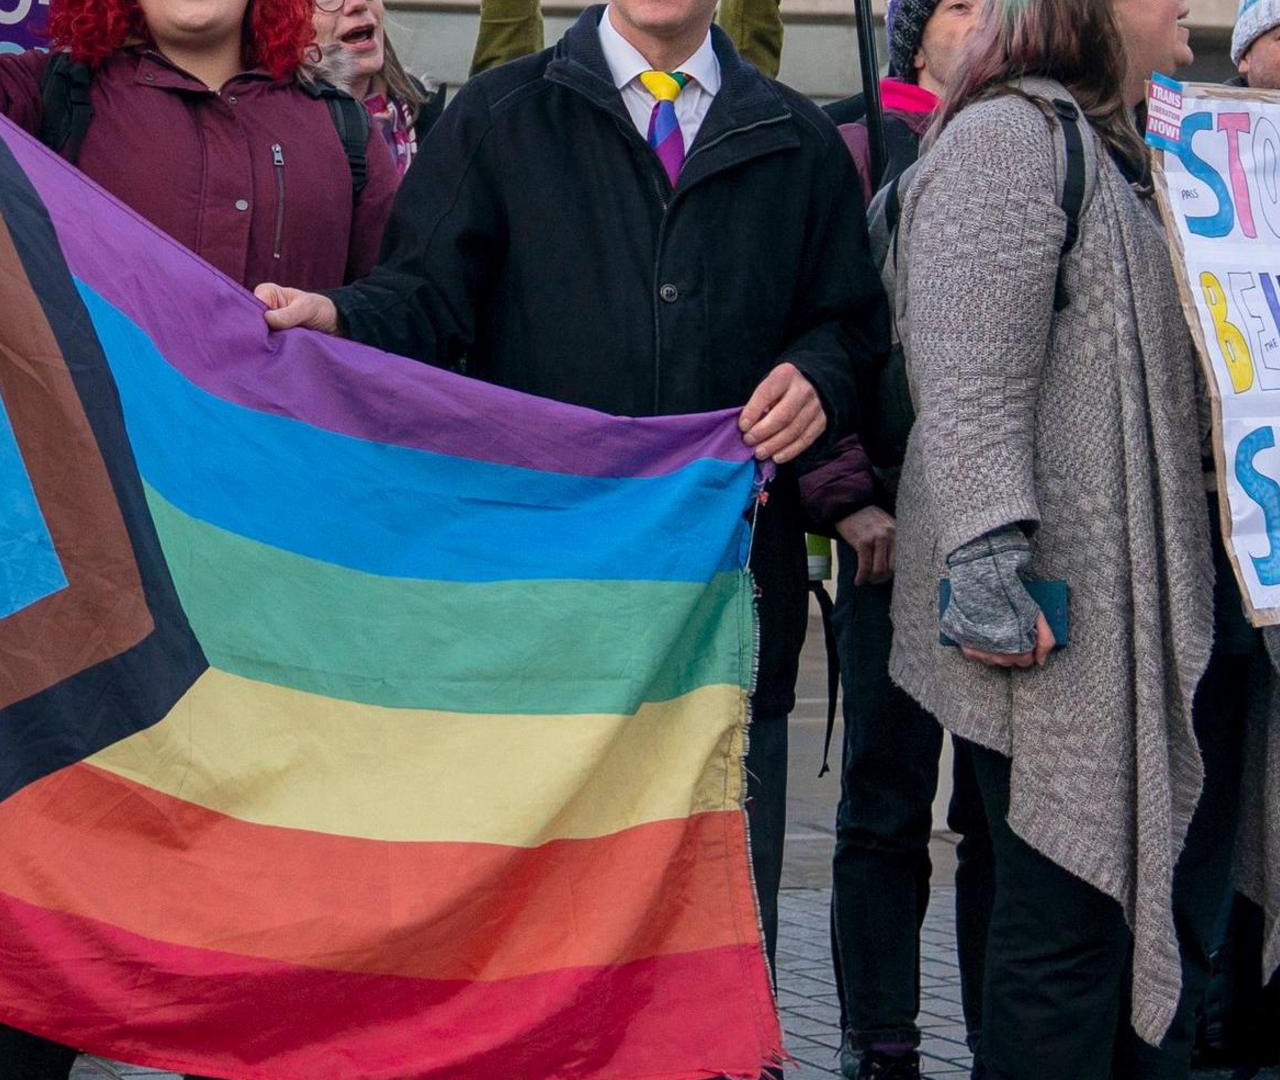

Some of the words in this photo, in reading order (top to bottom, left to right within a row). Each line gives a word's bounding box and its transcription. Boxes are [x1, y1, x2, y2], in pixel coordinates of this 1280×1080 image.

[1151, 84, 1181, 108] TRANS
[1148, 117, 1180, 140] NOW!
[1182, 189, 1199, 201] PASS
[1264, 337, 1279, 353] THE
